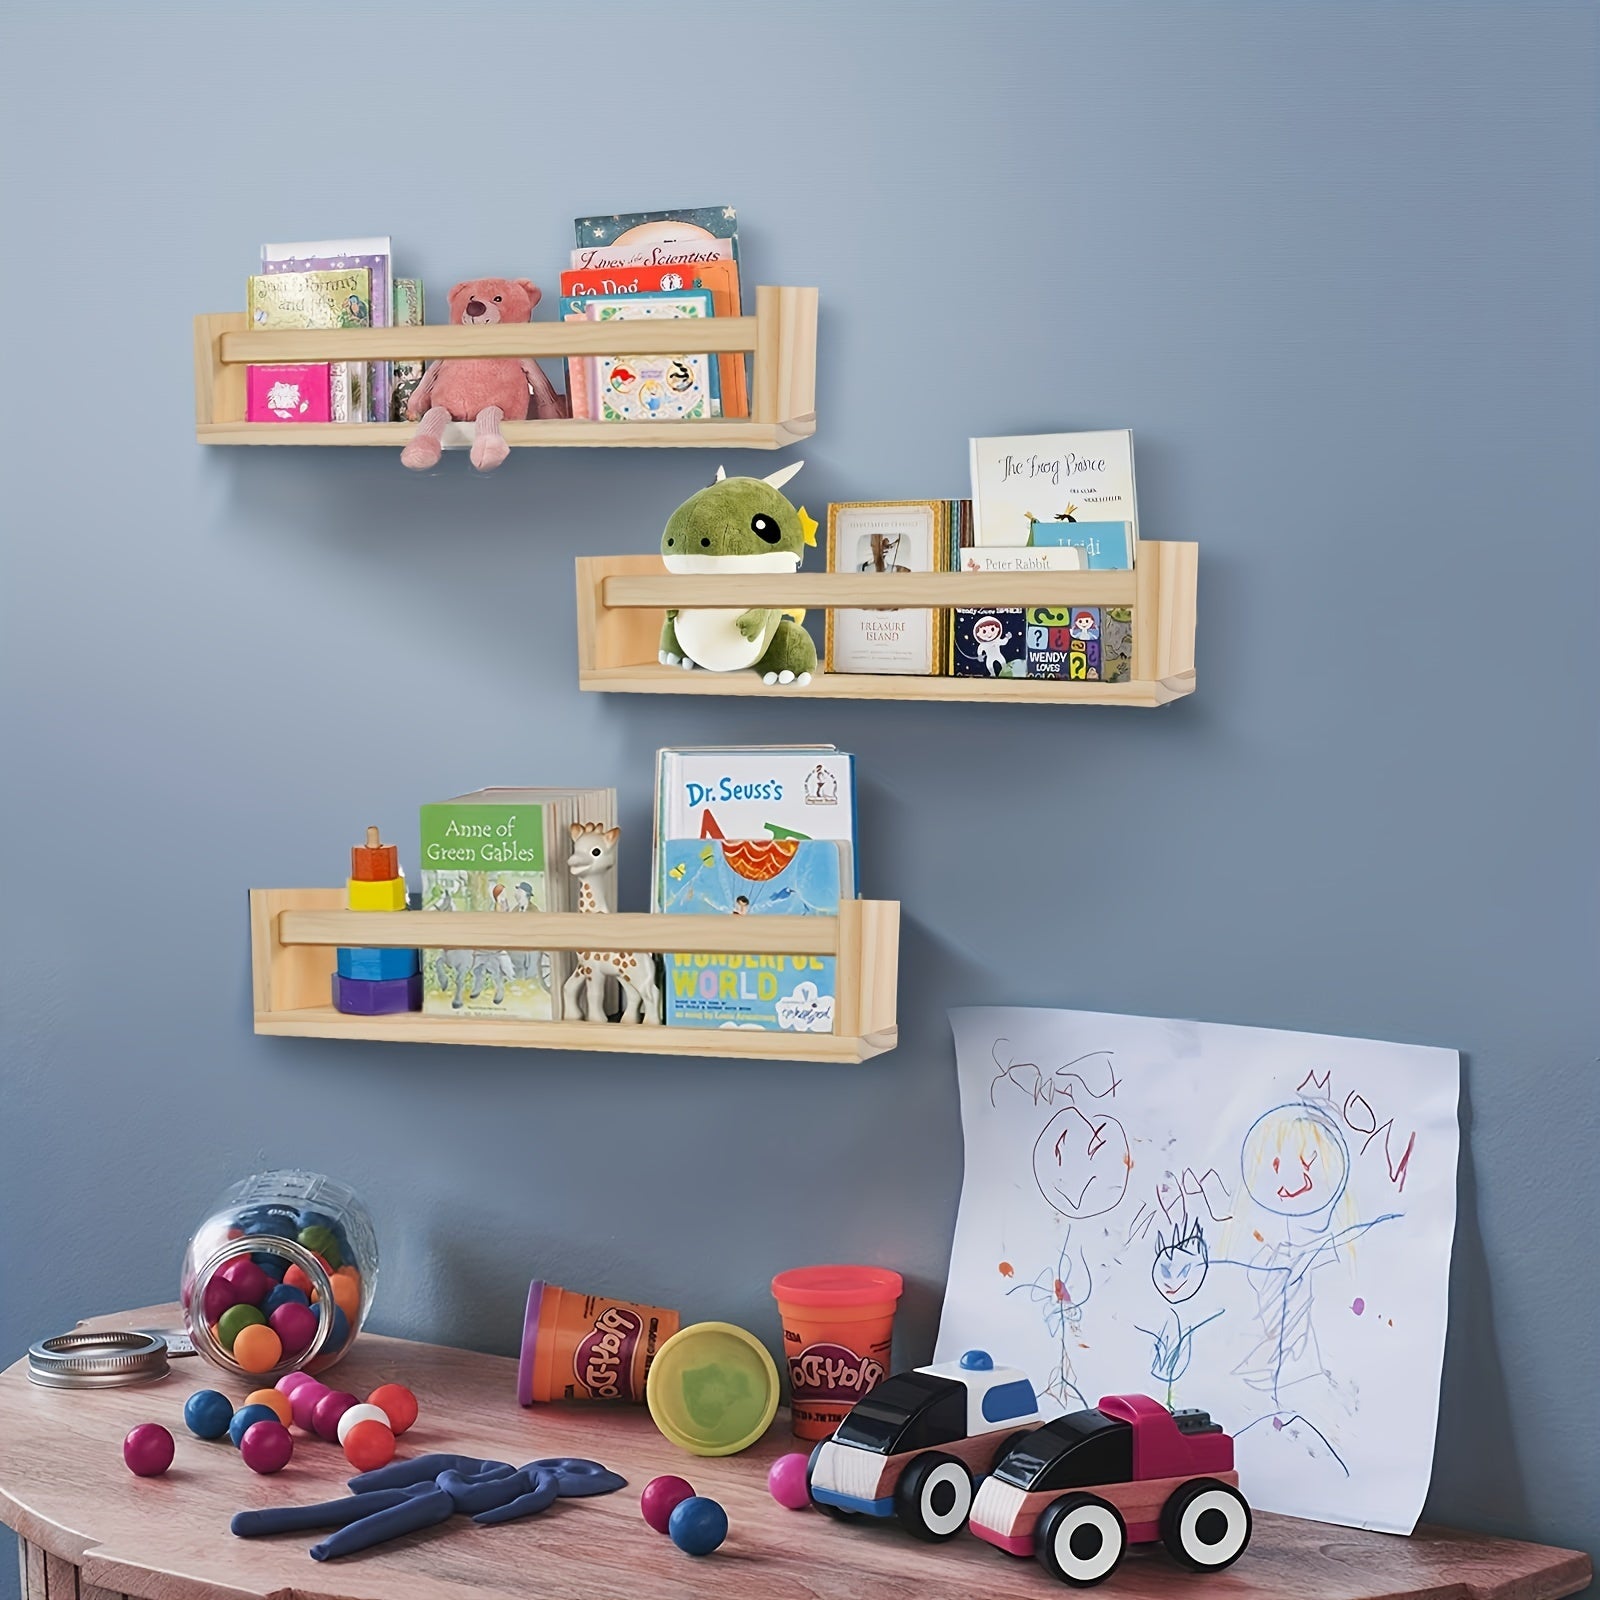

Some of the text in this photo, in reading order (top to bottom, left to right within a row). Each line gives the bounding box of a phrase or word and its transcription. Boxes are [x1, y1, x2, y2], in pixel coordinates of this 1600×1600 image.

[644, 247, 721, 267] Scientists
[998, 452, 1106, 485] The Frog Prince
[985, 557, 1050, 570] Peter Rabbit
[861, 621, 905, 631] TREASURE
[866, 631, 899, 641] ISLAND
[1029, 651, 1067, 662] WENDY
[1036, 663, 1060, 672] LOVES
[685, 783, 716, 808] Dr.
[719, 776, 783, 801] Seuss's
[445, 815, 516, 838] Anne of
[427, 840, 534, 862] Green Gables
[672, 969, 778, 1001] WORLD
